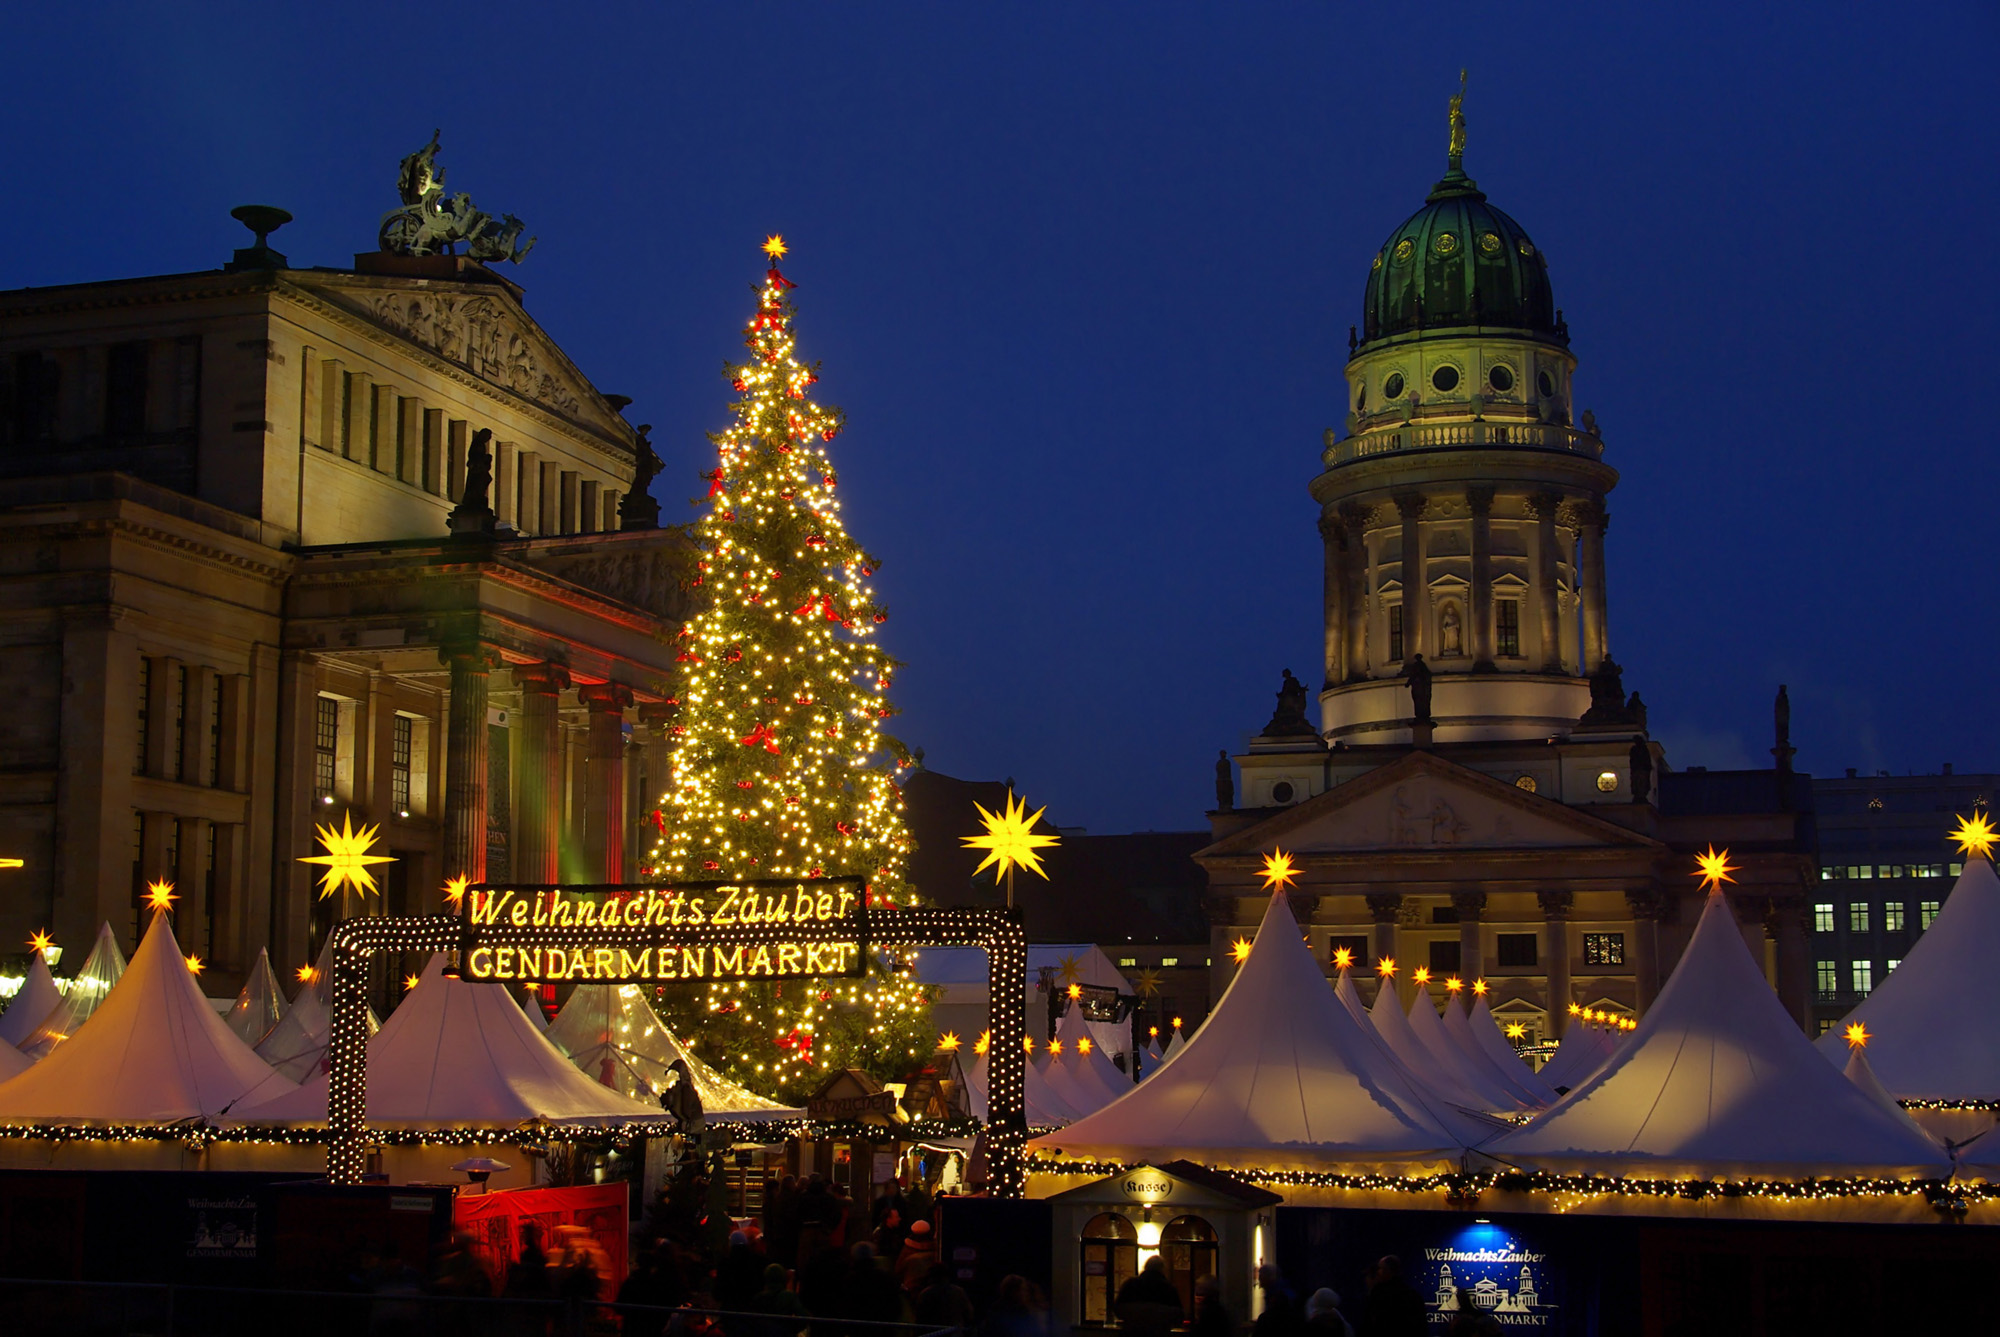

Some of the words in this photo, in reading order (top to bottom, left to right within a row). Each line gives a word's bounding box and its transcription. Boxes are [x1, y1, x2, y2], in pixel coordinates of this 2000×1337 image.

[469, 942, 856, 979] GENDARMENMARKT
[1127, 1181, 1166, 1192] Kasse
[1424, 1248, 1546, 1263] WeihnachtsZauber
